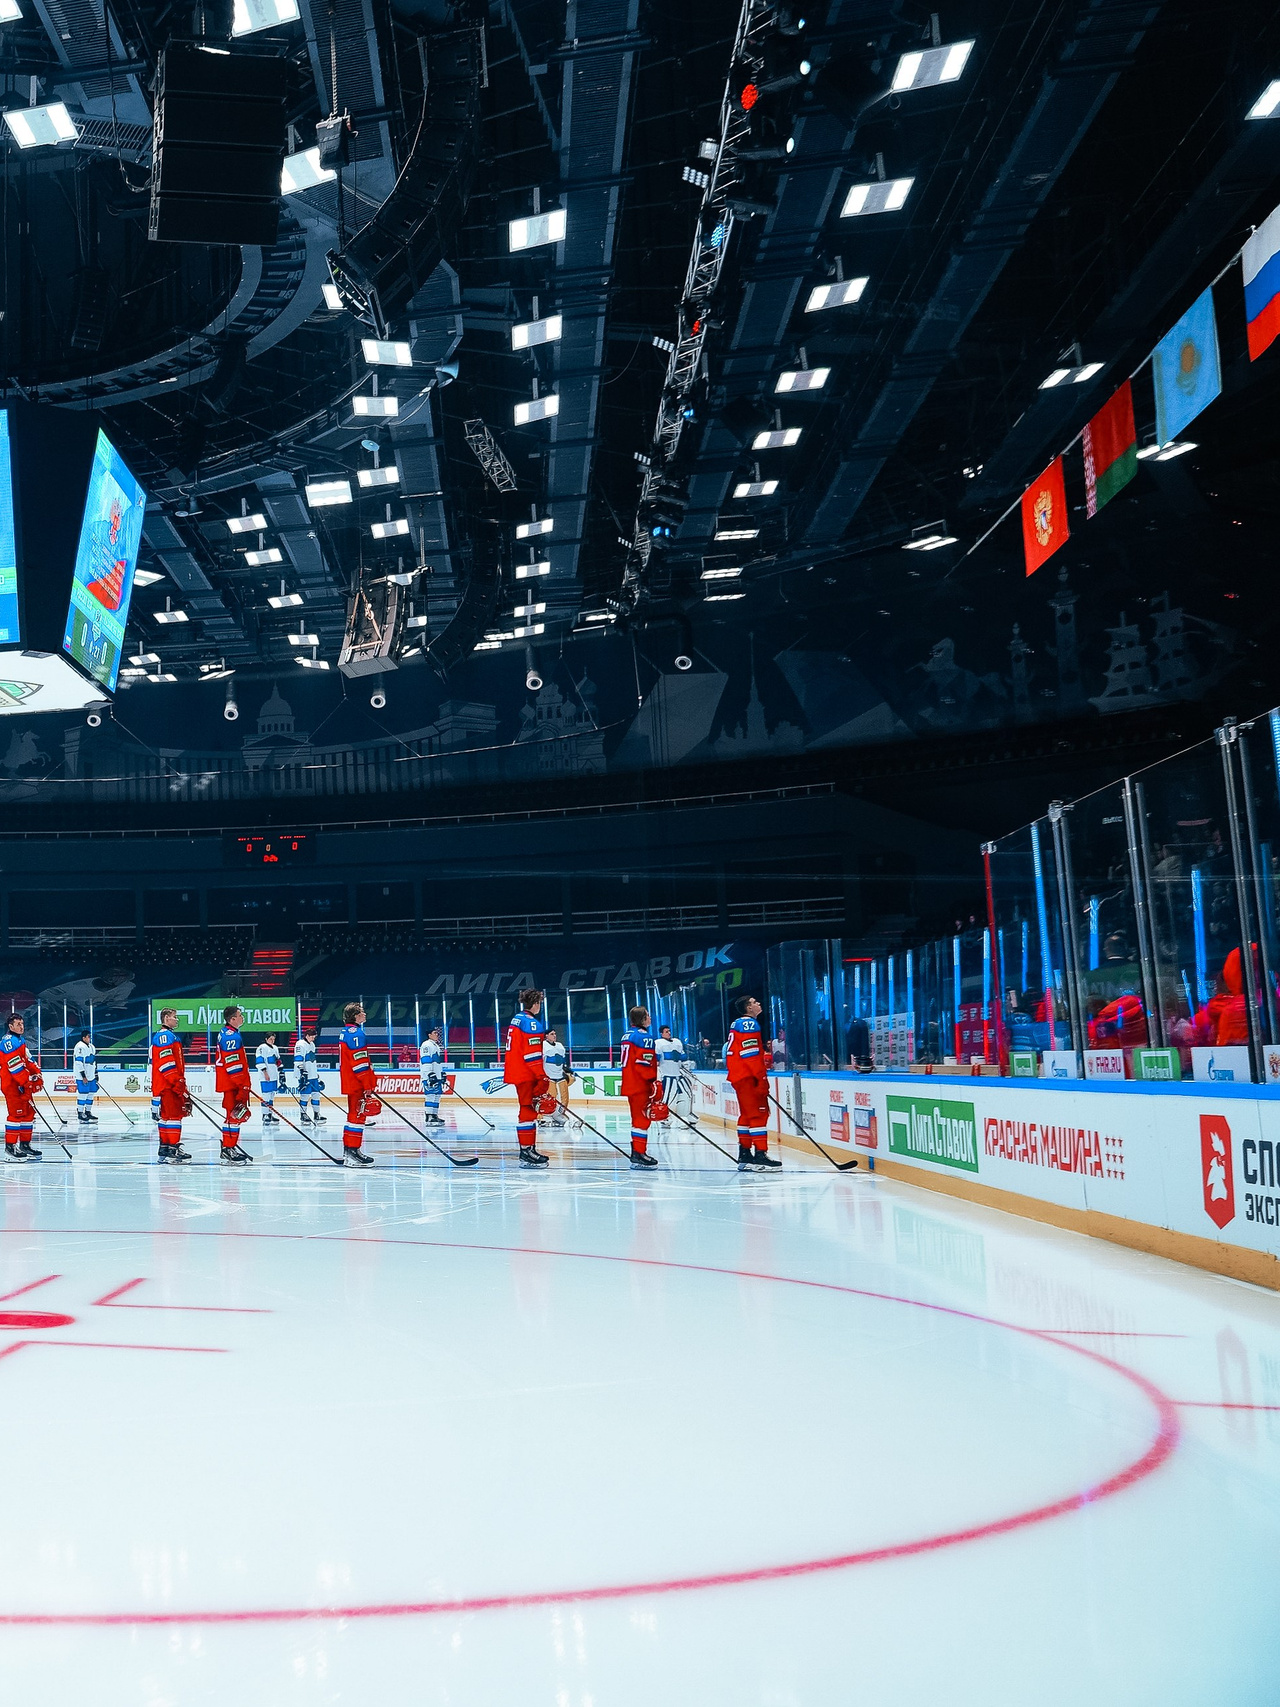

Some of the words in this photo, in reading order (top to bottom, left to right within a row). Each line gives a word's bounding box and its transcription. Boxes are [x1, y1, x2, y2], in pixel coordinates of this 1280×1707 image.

[246, 844, 252, 852] 0
[292, 842, 298, 850] 0
[425, 972, 534, 996] ЛИГА
[558, 942, 736, 991] СТАВОК
[530, 1022, 536, 1030] 5
[742, 1020, 755, 1031] 32
[158, 1034, 168, 1045] 10
[352, 1037, 359, 1047] 7
[643, 1038, 654, 1048] 27
[4, 1040, 12, 1052] 13
[226, 1040, 236, 1050] 22
[1096, 1056, 1121, 1073] FHR.RU
[984, 1117, 1038, 1166] КРАСНАЯ
[1040, 1124, 1104, 1178] МАШИНА
